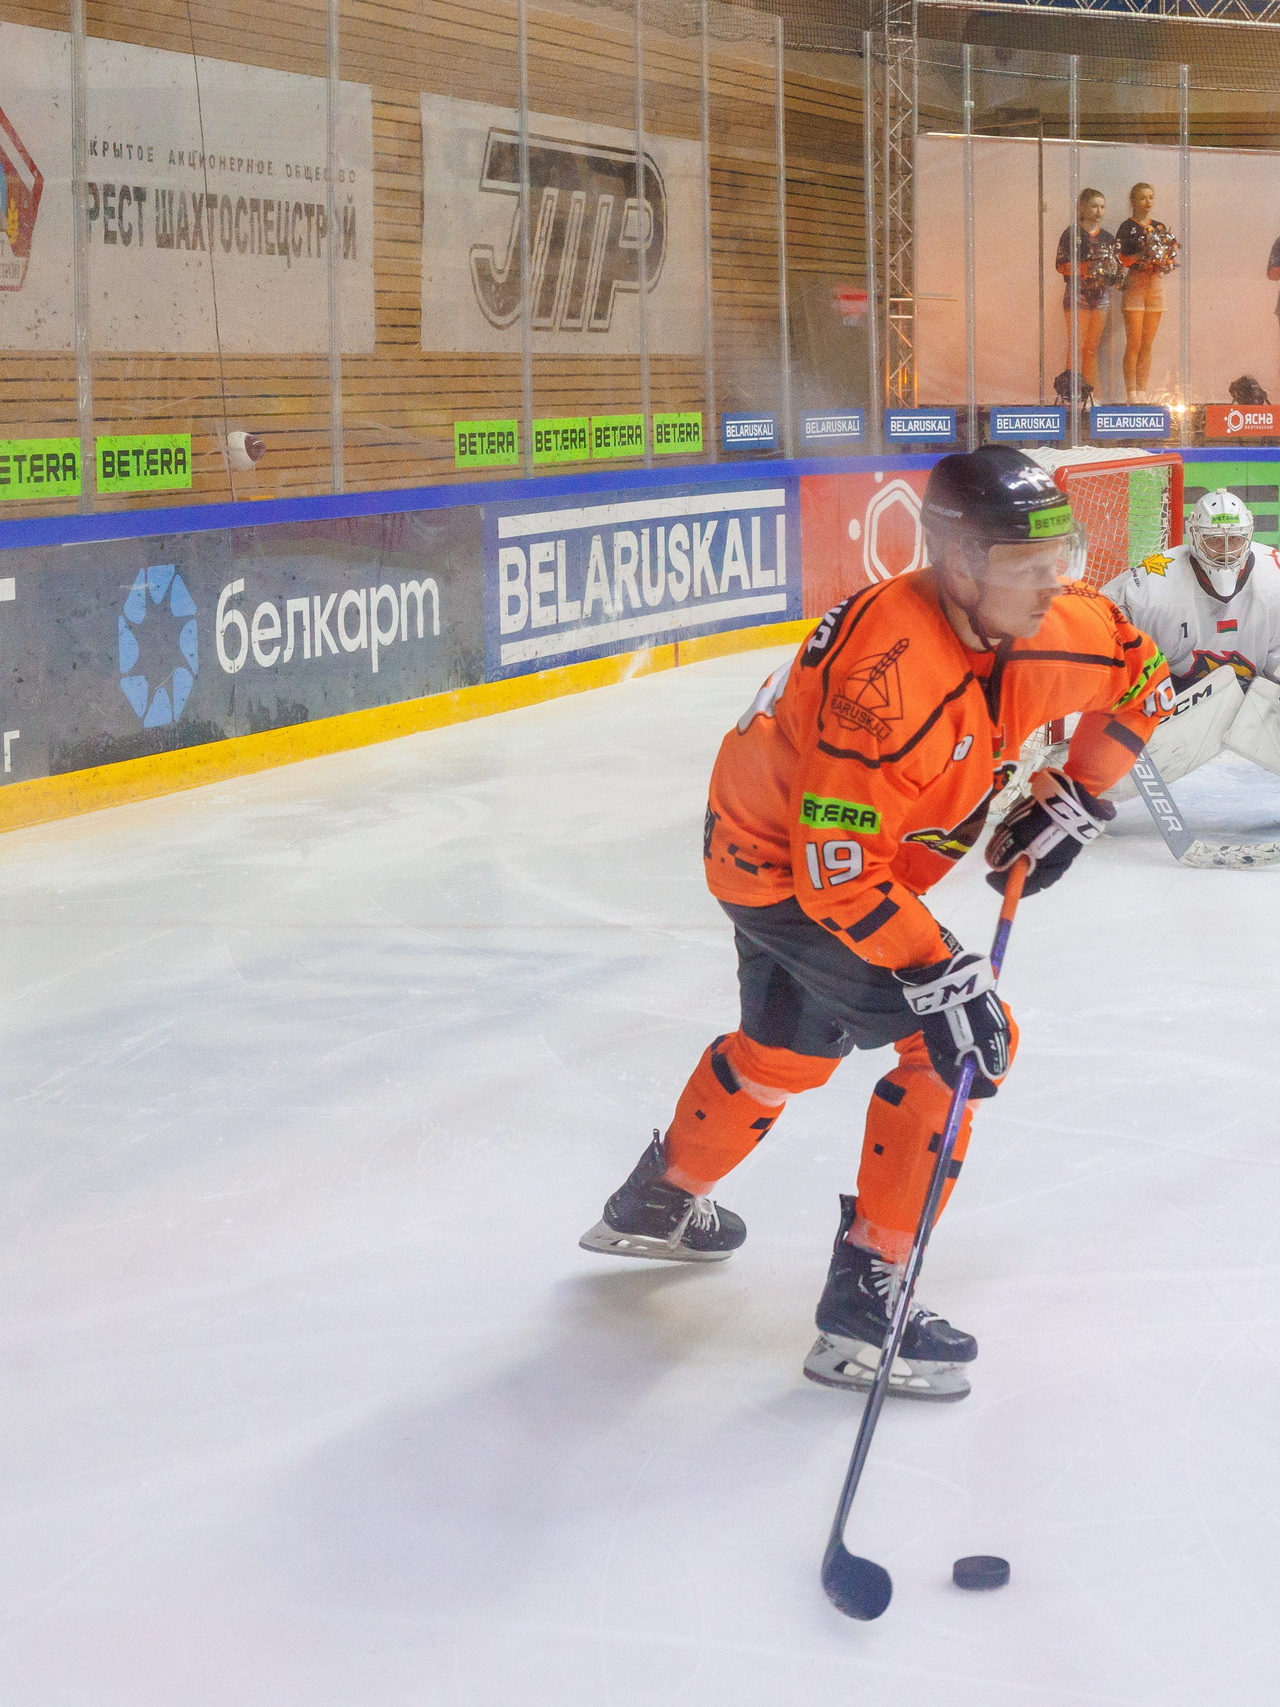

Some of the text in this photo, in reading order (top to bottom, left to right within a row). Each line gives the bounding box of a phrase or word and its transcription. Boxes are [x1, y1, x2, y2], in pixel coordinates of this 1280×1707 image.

[73, 181, 147, 247] РЕСТ
[726, 423, 774, 438] BELARUSKALI
[805, 419, 860, 434] BELARUSKALI
[890, 420, 951, 432] BELARUSKALI
[996, 418, 1060, 430] BELARUSKALI
[1096, 417, 1164, 428] BELARUSKALI
[0, 453, 76, 484] ET.ERA
[498, 514, 787, 635] BELARUSKALI
[215, 577, 440, 674] белкарт
[1180, 622, 1188, 639] 1
[1159, 684, 1213, 725] CM
[806, 840, 864, 890] 19
